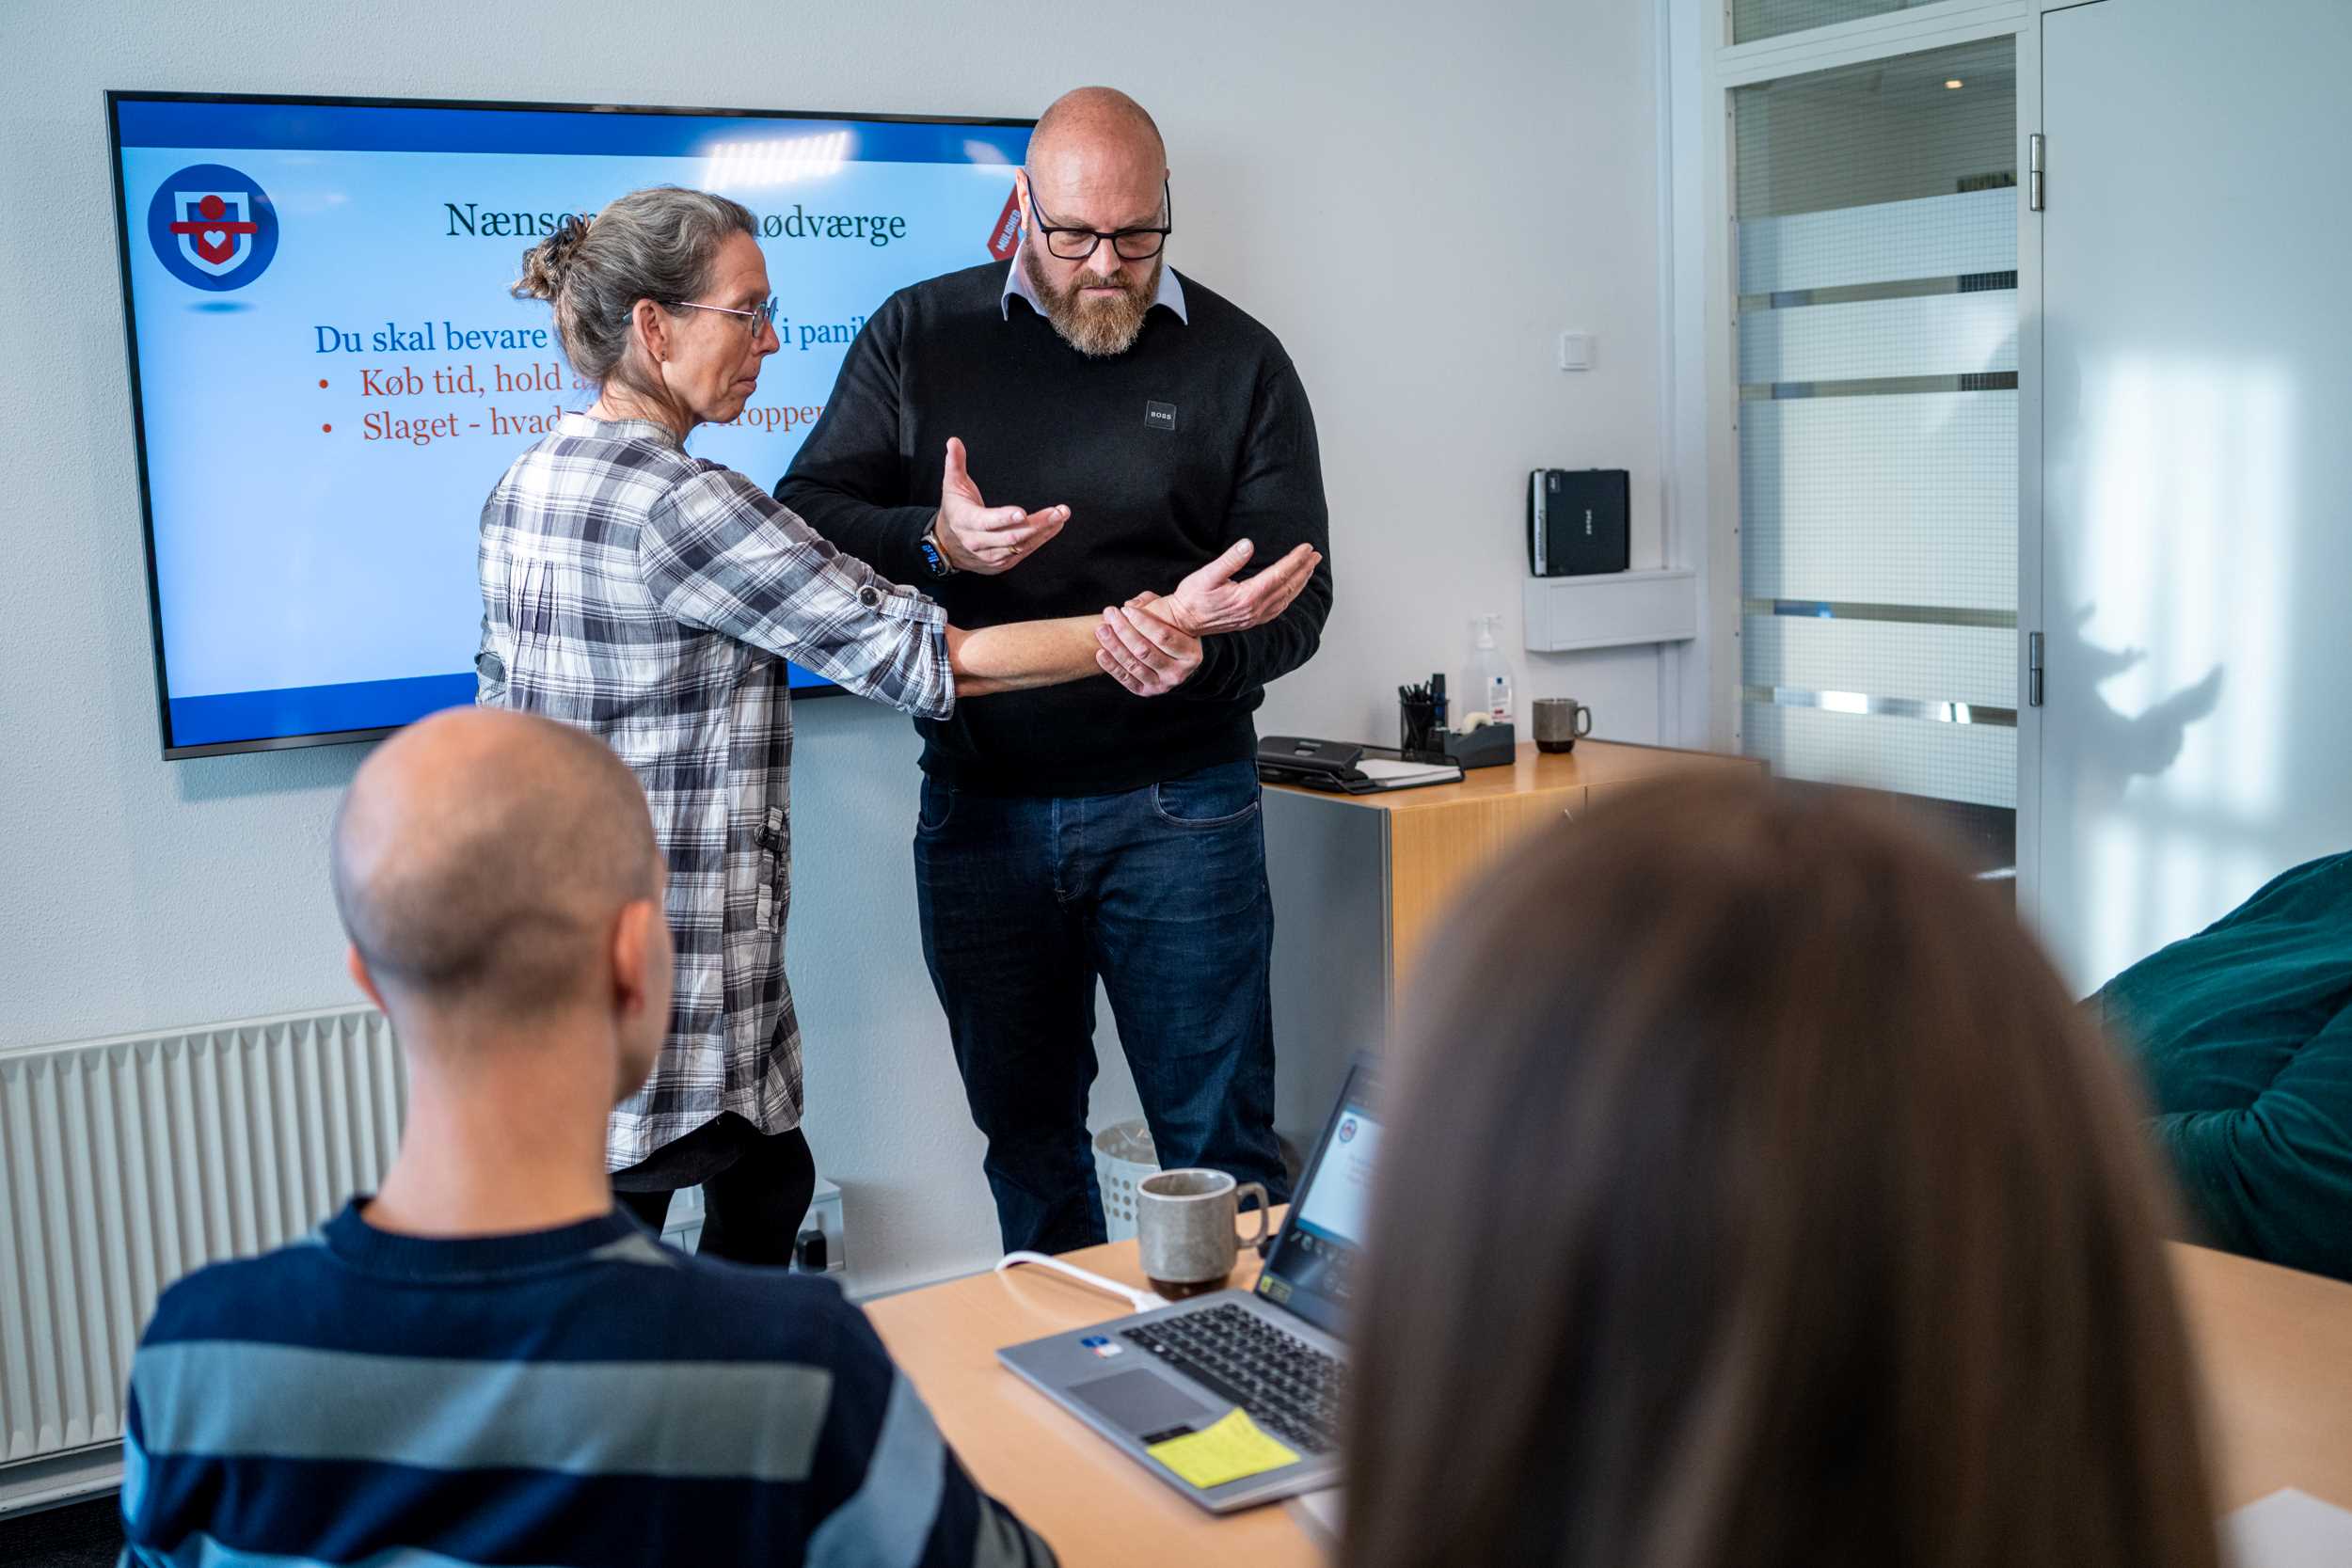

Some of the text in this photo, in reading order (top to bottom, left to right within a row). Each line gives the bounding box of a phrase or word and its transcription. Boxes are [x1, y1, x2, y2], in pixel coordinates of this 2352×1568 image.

[756, 204, 907, 247] ødværge
[313, 325, 363, 354] Du
[373, 322, 437, 353] skal
[443, 322, 548, 351] bevare
[782, 317, 792, 344] i
[359, 366, 423, 397] Køb
[433, 365, 485, 398] tid,
[493, 362, 564, 392] hold
[363, 411, 459, 446] Slaget
[1151, 411, 1171, 420] BOSS
